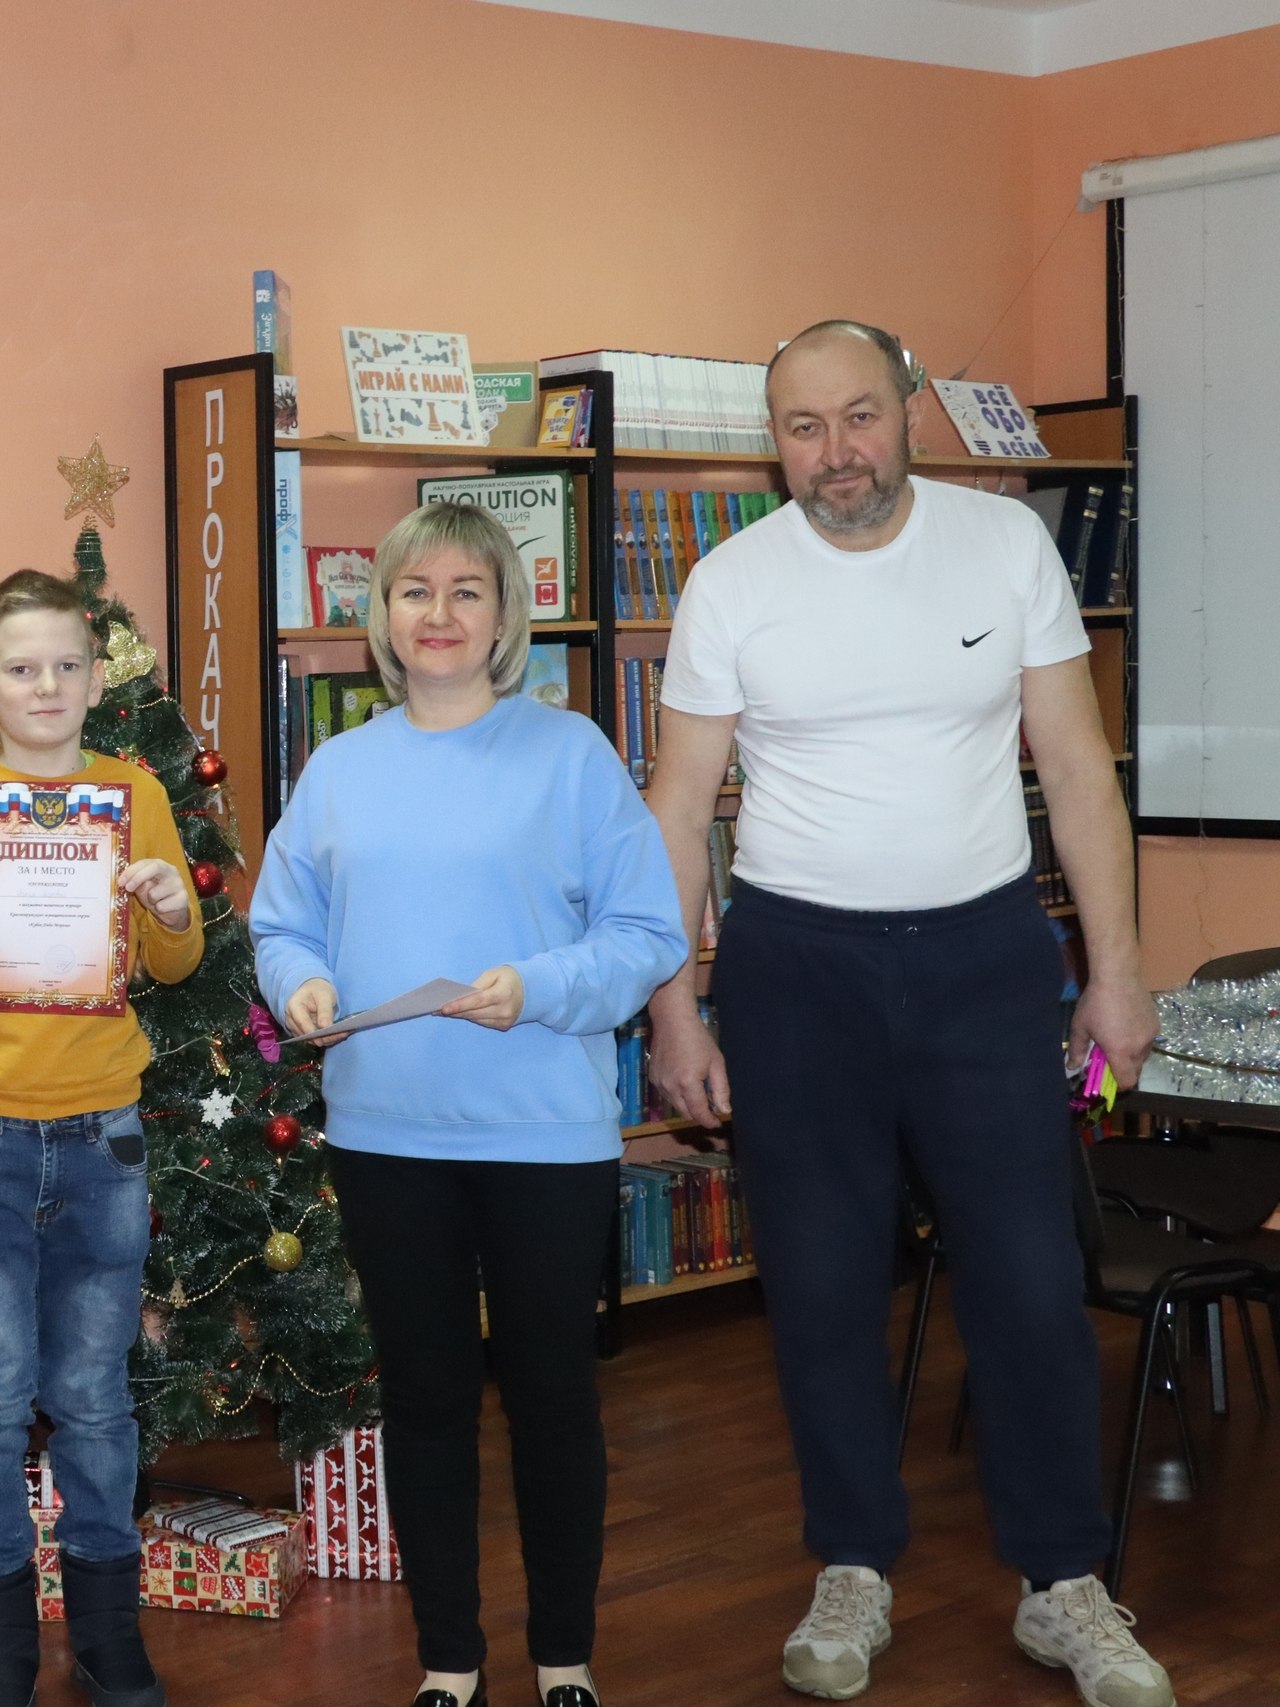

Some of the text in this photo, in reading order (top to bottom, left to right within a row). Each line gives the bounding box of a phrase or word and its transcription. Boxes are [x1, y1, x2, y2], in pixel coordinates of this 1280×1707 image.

[358, 367, 465, 394] ИГРАЙ С НАМИ
[475, 378, 521, 389] ОДСКАЯ
[972, 384, 1013, 407] ВСЁ
[981, 406, 1025, 433] ОБО
[200, 388, 225, 815] ПРОКАЧ
[17, 866, 30, 875] ЗА
[40, 866, 76, 876] МЕСТО
